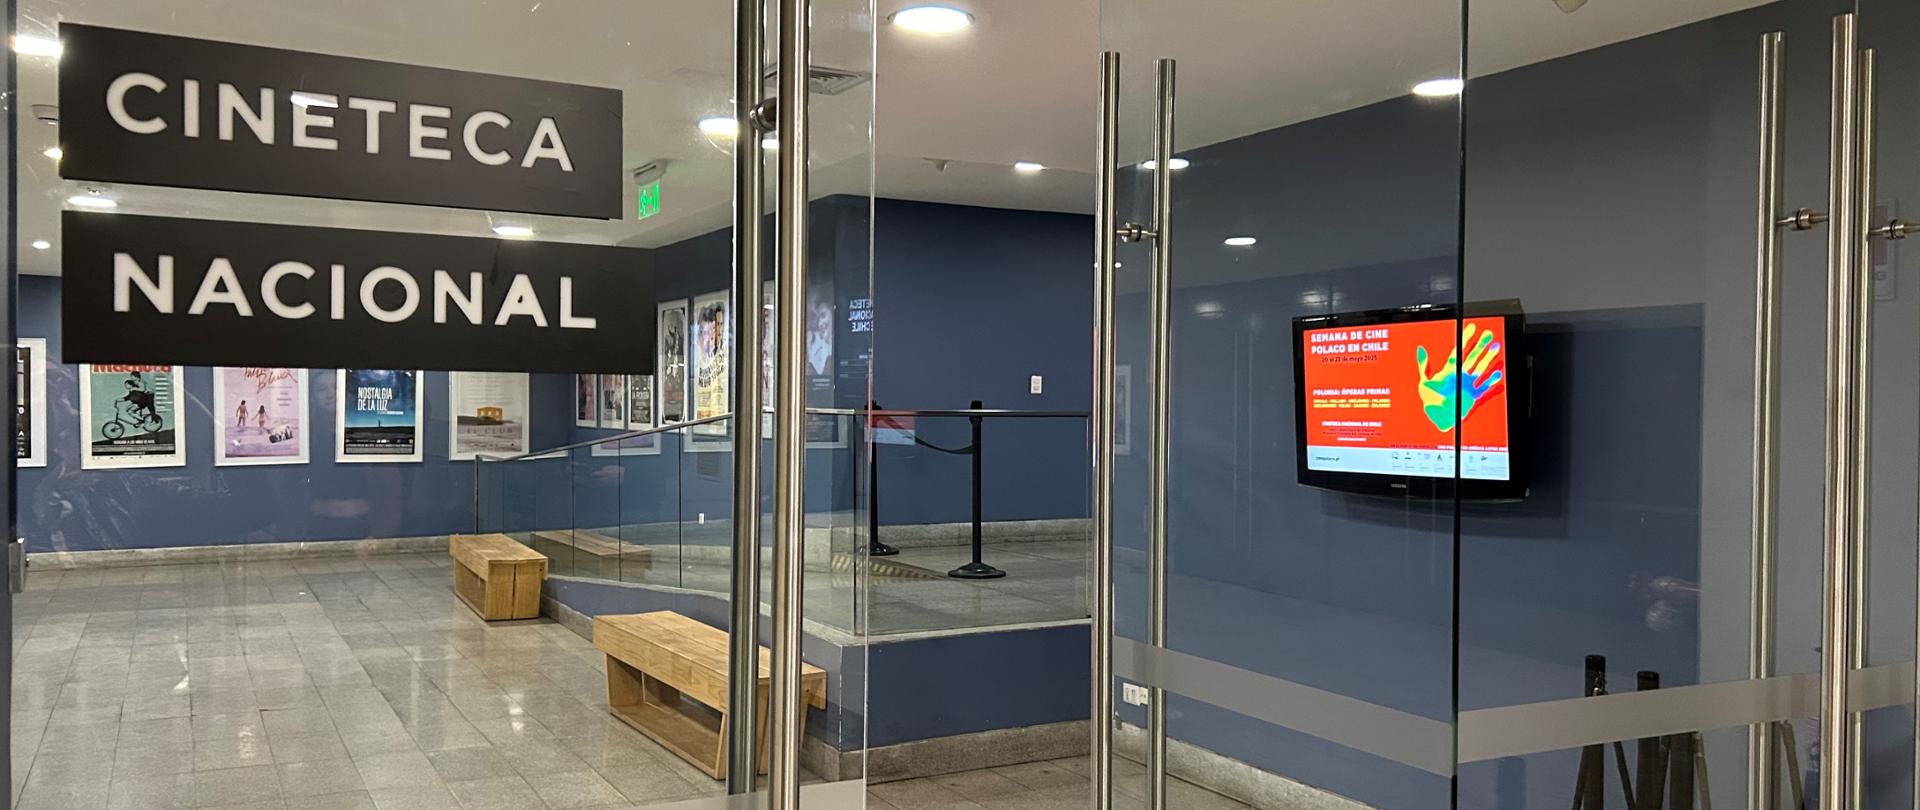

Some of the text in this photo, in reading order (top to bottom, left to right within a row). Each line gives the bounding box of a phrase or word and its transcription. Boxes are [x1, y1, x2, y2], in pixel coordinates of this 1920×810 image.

[106, 72, 574, 172] CINETECA
[113, 252, 597, 329] NACIONAL
[1311, 329, 1389, 342] SEMANA DE CINE
[1311, 342, 1389, 354] POLACO EN CHILE
[357, 387, 393, 400] NOSTALGIA
[357, 399, 388, 411] DE LA LUZ
